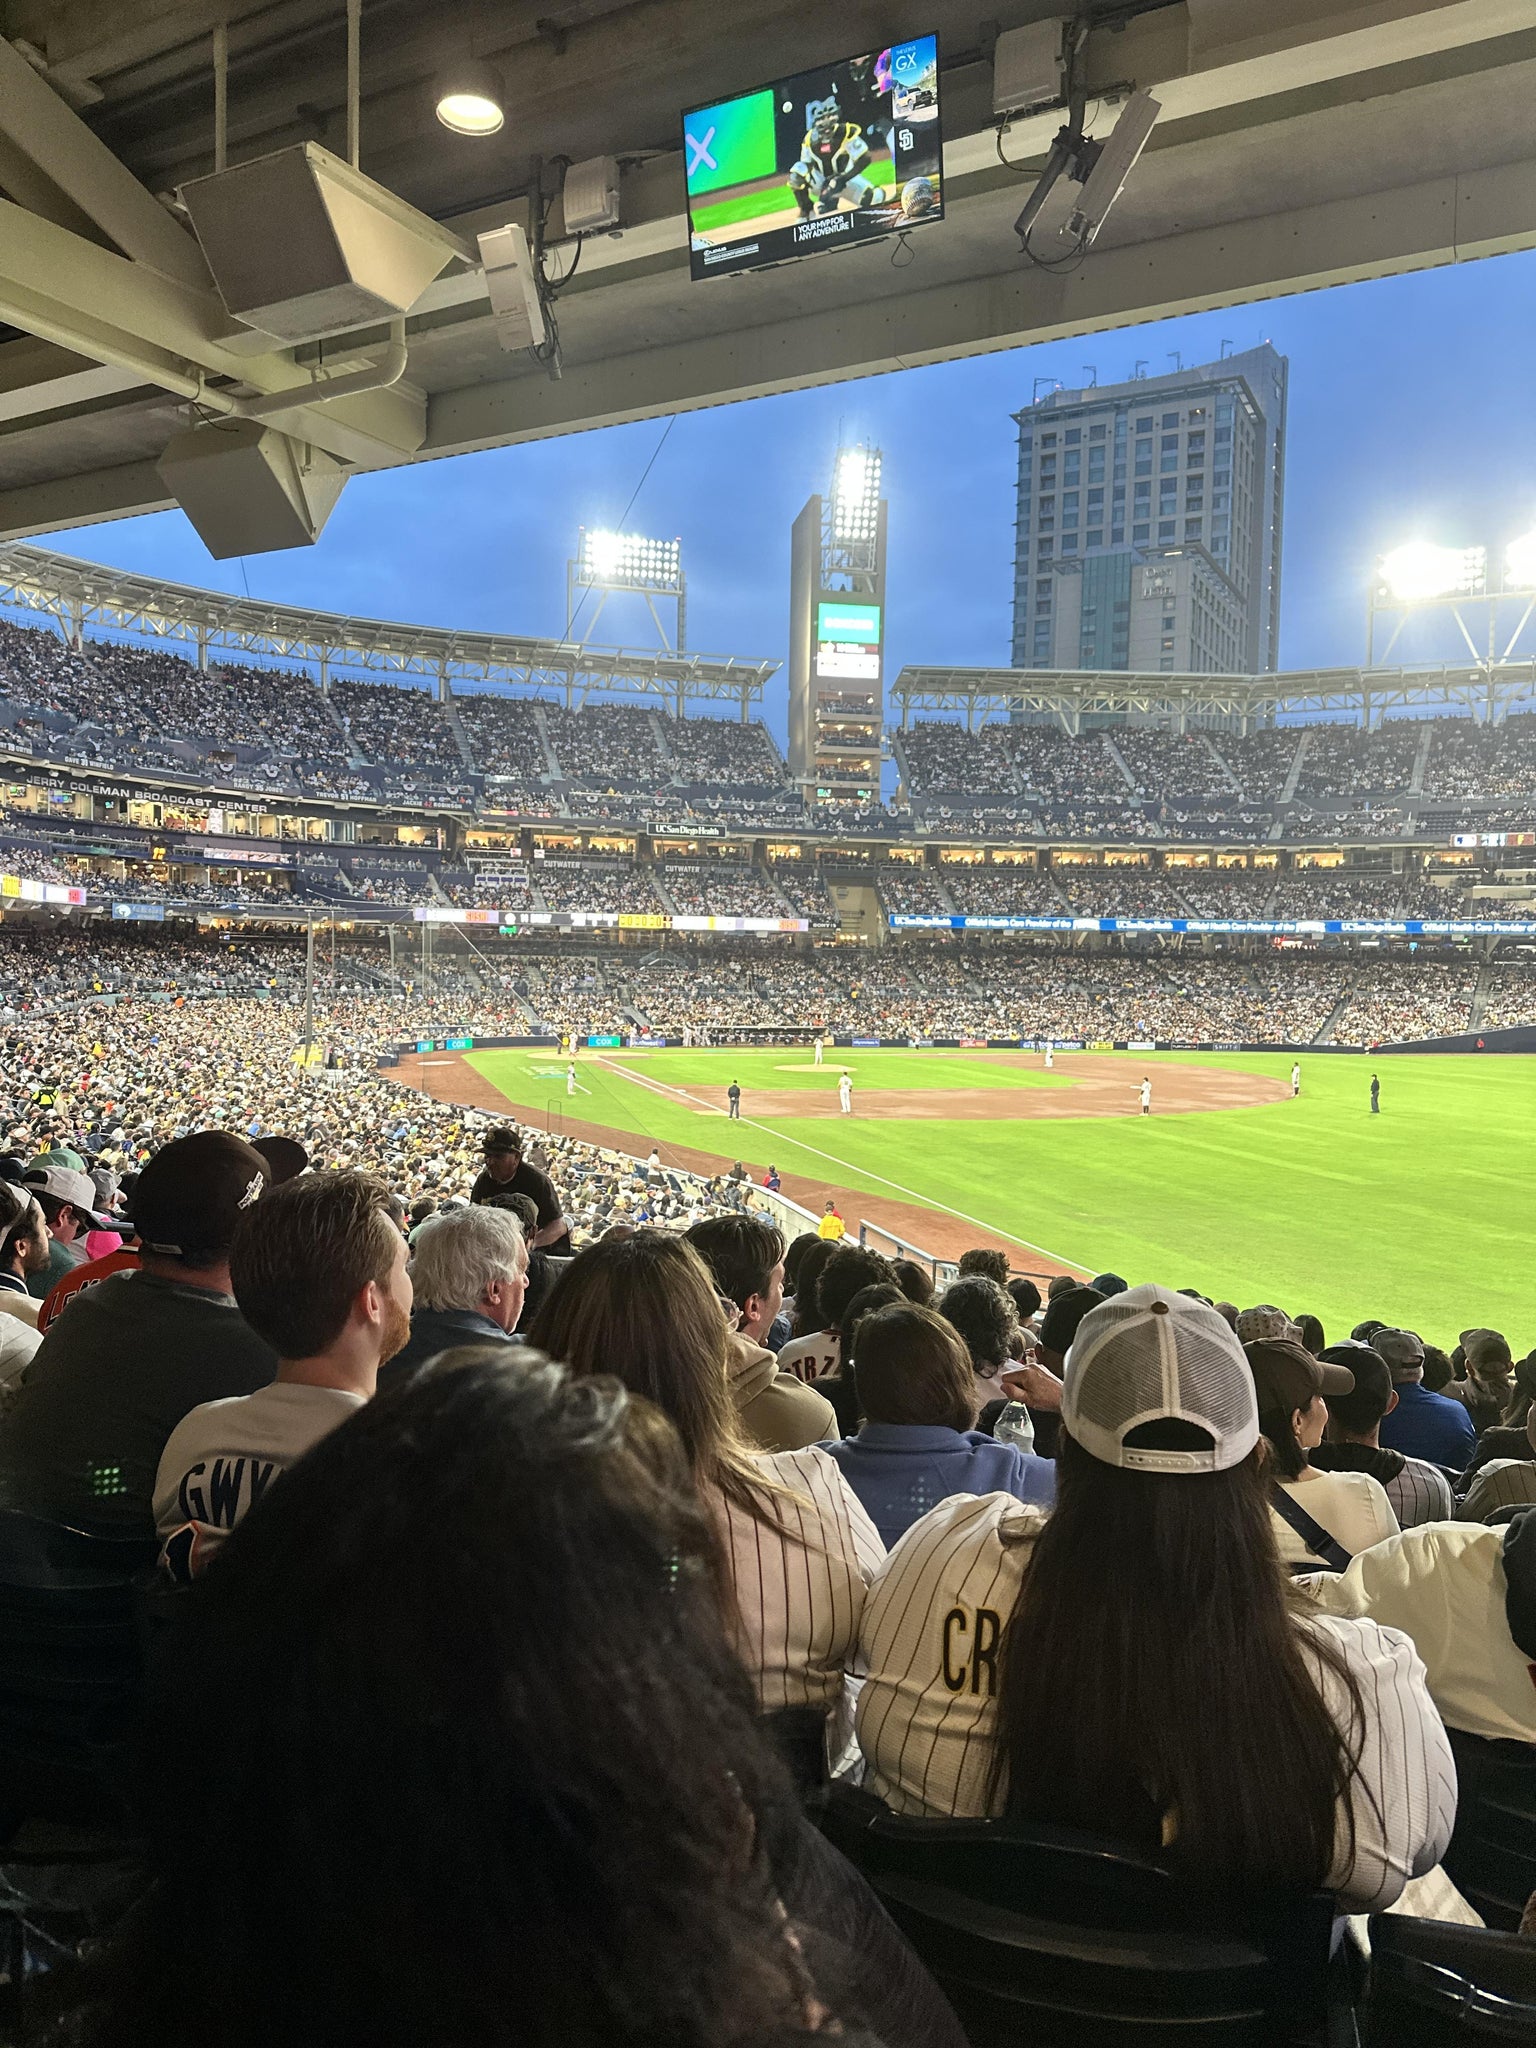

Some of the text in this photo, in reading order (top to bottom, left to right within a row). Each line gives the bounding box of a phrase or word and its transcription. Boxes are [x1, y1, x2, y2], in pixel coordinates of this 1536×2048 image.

[896, 52, 917, 71] GX
[798, 216, 844, 233] YOUR MVP FOR
[798, 222, 849, 242] ANY ADVENTURE
[27, 776, 268, 813] JERRY COLEMAN BROADCAST CENTER
[656, 825, 719, 836] UC San Diego Health
[544, 860, 581, 868] CUTWATER
[1010, 919, 1024, 927] Care
[1475, 923, 1493, 931] Care
[944, 1608, 1000, 1696] CR
